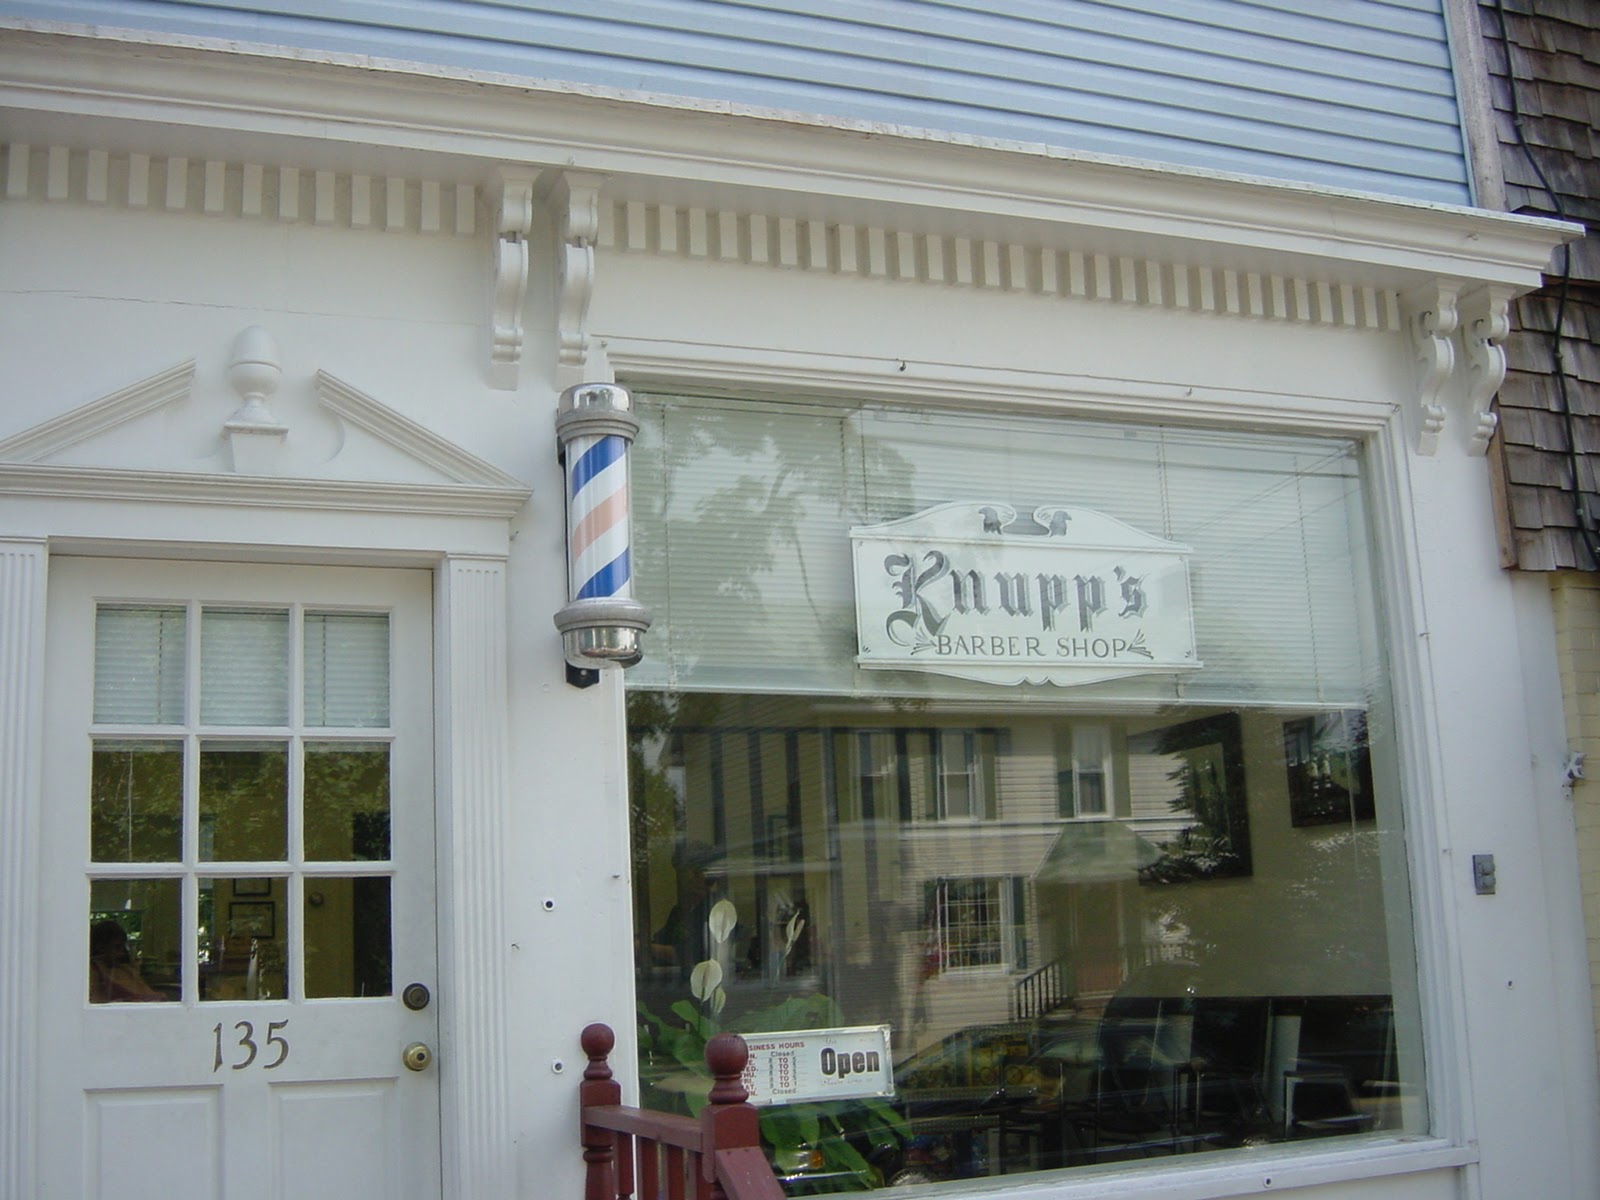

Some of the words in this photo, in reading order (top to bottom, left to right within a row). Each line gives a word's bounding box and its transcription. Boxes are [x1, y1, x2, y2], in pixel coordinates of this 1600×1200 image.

[883, 549, 1151, 647] Knupp's
[936, 633, 1046, 658] BARBER
[1056, 635, 1127, 659] SHOP
[213, 1019, 289, 1073] 135
[748, 1043, 776, 1051] SINESS
[778, 1041, 805, 1049] HOURS
[820, 1047, 880, 1079] Open
